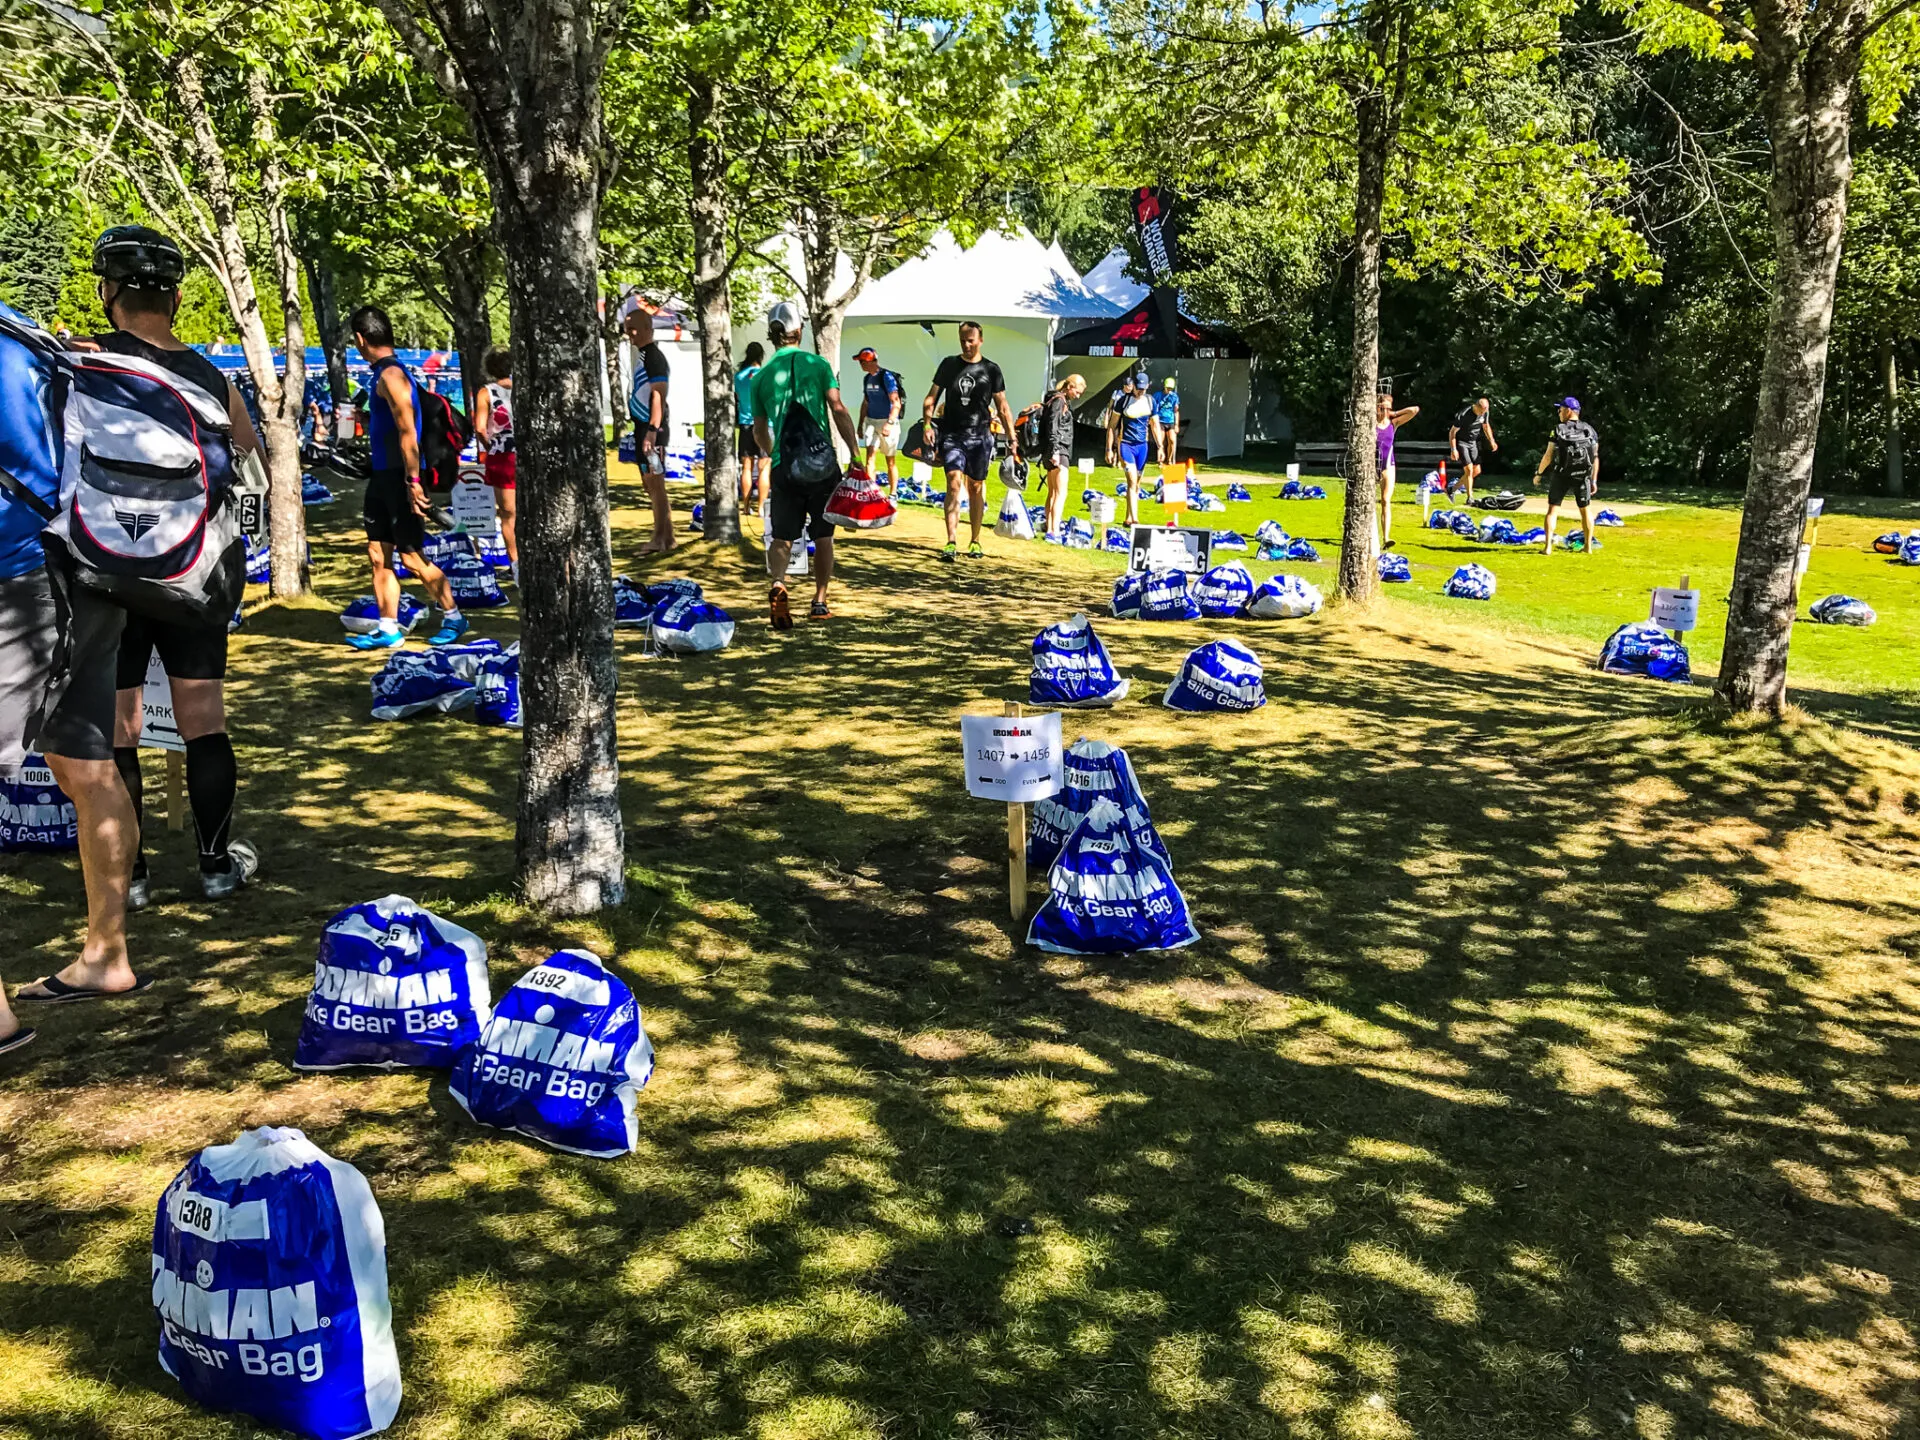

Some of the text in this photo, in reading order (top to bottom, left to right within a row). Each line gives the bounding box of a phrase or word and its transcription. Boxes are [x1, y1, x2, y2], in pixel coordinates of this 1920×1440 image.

[1142, 225, 1161, 277] CHANGE
[1089, 342, 1139, 357] IRONMAN
[242, 496, 256, 534] 1679
[1057, 668, 1087, 680] Gear
[1187, 679, 1214, 700] Bike
[1217, 694, 1252, 709] Gear
[993, 726, 1032, 737] IRONMAN
[977, 747, 1050, 763] 1407 1456
[24, 770, 51, 782] 1006
[1069, 772, 1090, 787] 1416
[16, 826, 60, 843] Gear
[1031, 817, 1059, 845] Bike
[1084, 899, 1138, 918] Gear
[528, 970, 568, 990] 1392
[332, 1004, 397, 1034] Gear
[404, 1009, 459, 1034] Bag
[481, 1054, 542, 1091] Gear
[545, 1069, 607, 1108] Bag
[178, 1199, 214, 1232] 1388
[163, 1318, 324, 1383] Gear Bag
